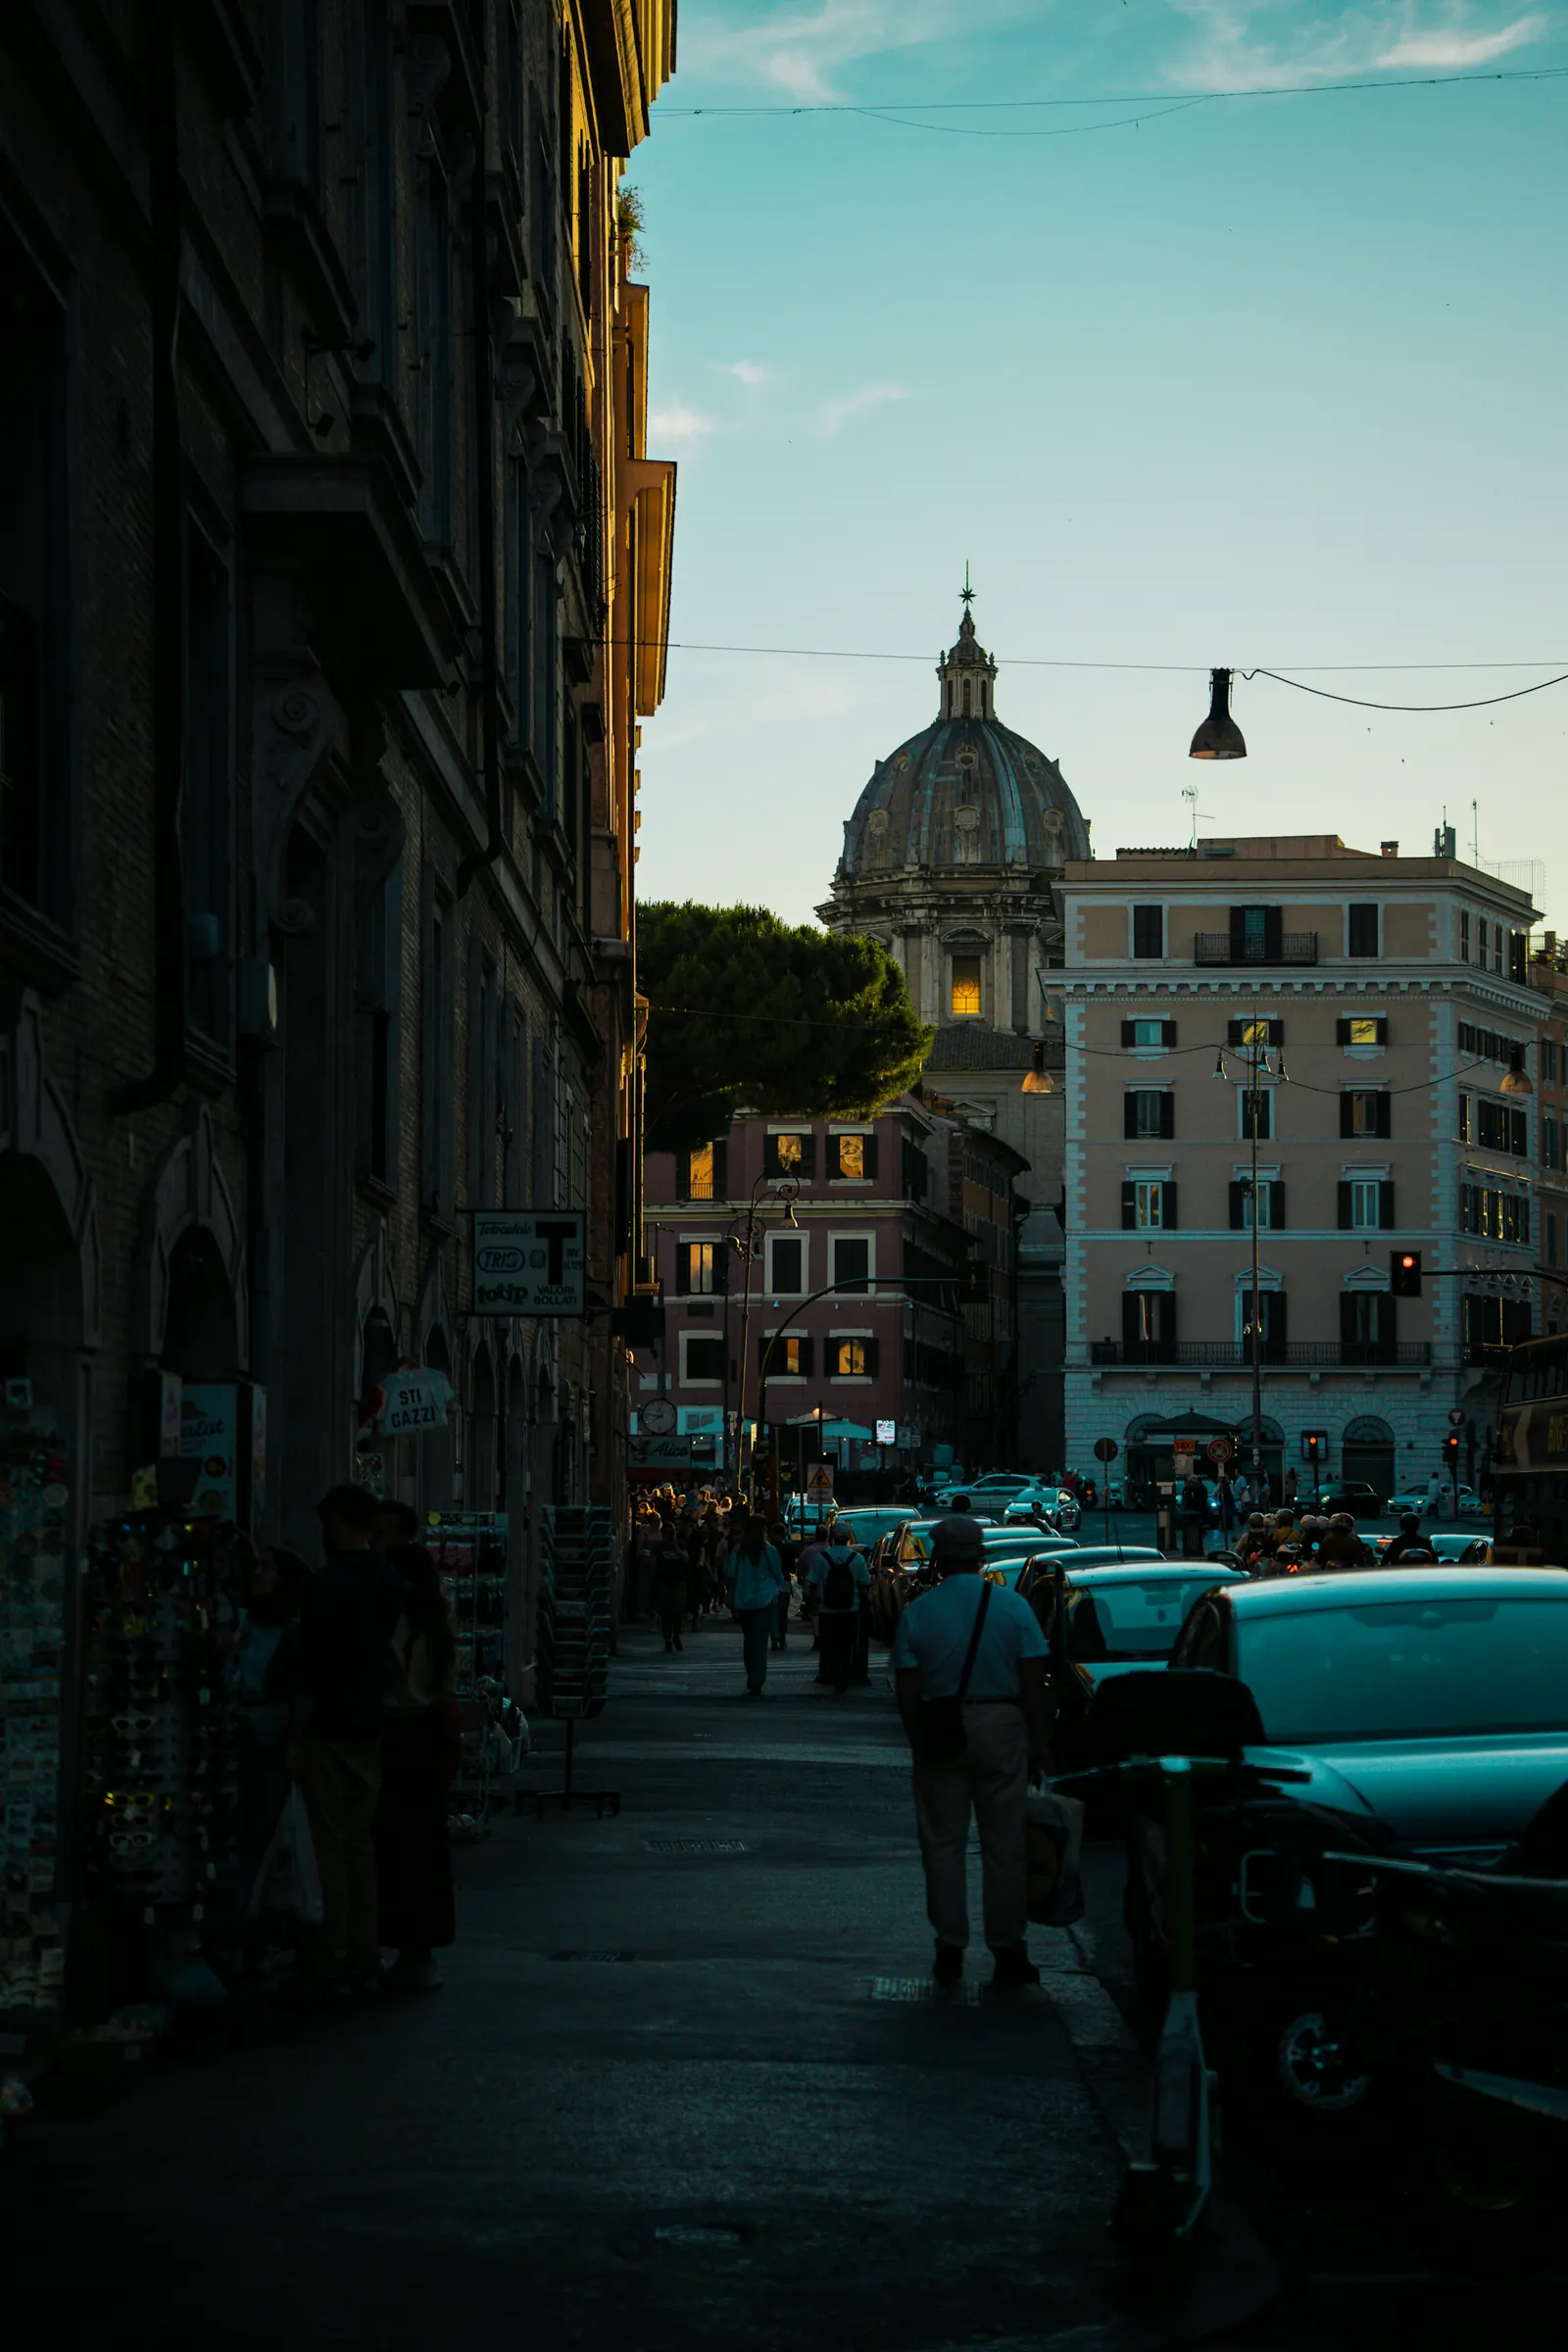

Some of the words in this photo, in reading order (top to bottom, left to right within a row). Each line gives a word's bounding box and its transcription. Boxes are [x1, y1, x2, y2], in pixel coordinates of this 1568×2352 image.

[535, 1221, 577, 1285] T
[537, 1285, 575, 1295] VALORI
[533, 1296, 577, 1305] BOLLATI
[399, 1388, 421, 1406] STI
[391, 1406, 436, 1428] CAZZI
[649, 1441, 689, 1458] Alice
